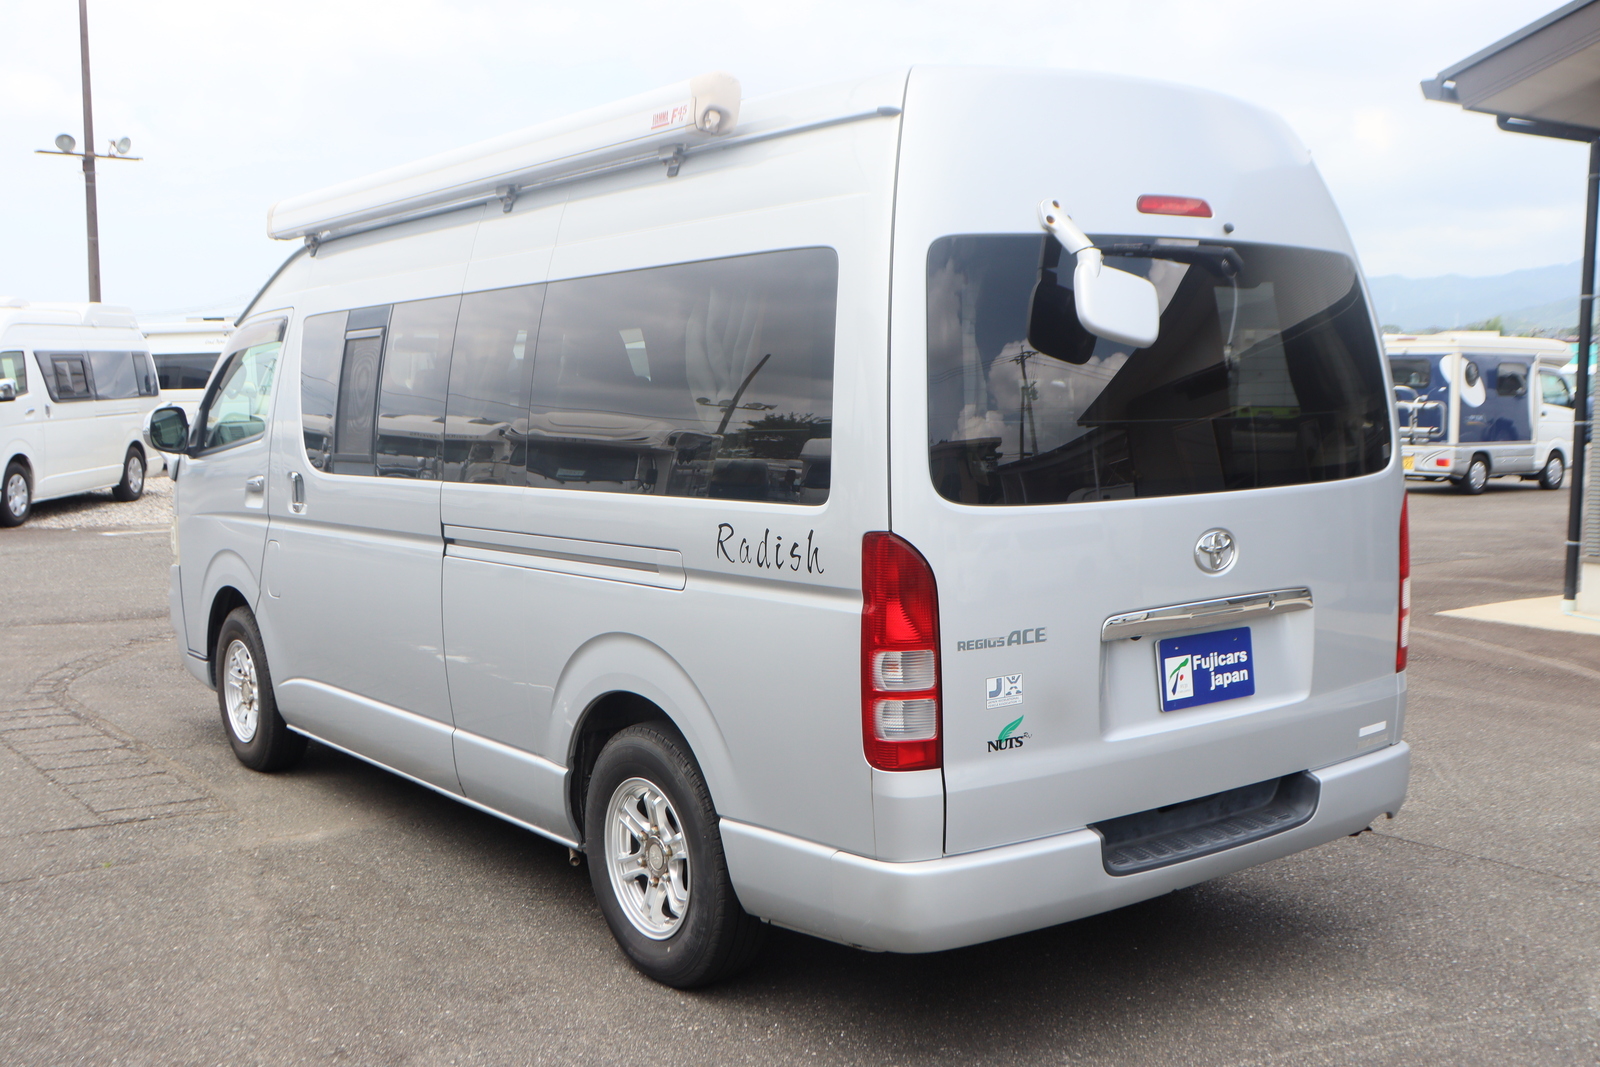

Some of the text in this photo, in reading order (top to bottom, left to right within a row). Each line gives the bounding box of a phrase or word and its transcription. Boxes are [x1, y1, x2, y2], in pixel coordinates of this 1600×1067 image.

[716, 522, 825, 574] Radish
[957, 627, 1048, 652] REGIUS ACE
[1193, 650, 1248, 671] Fujicars
[1210, 669, 1249, 690] japan
[987, 735, 1025, 753] NUTS
